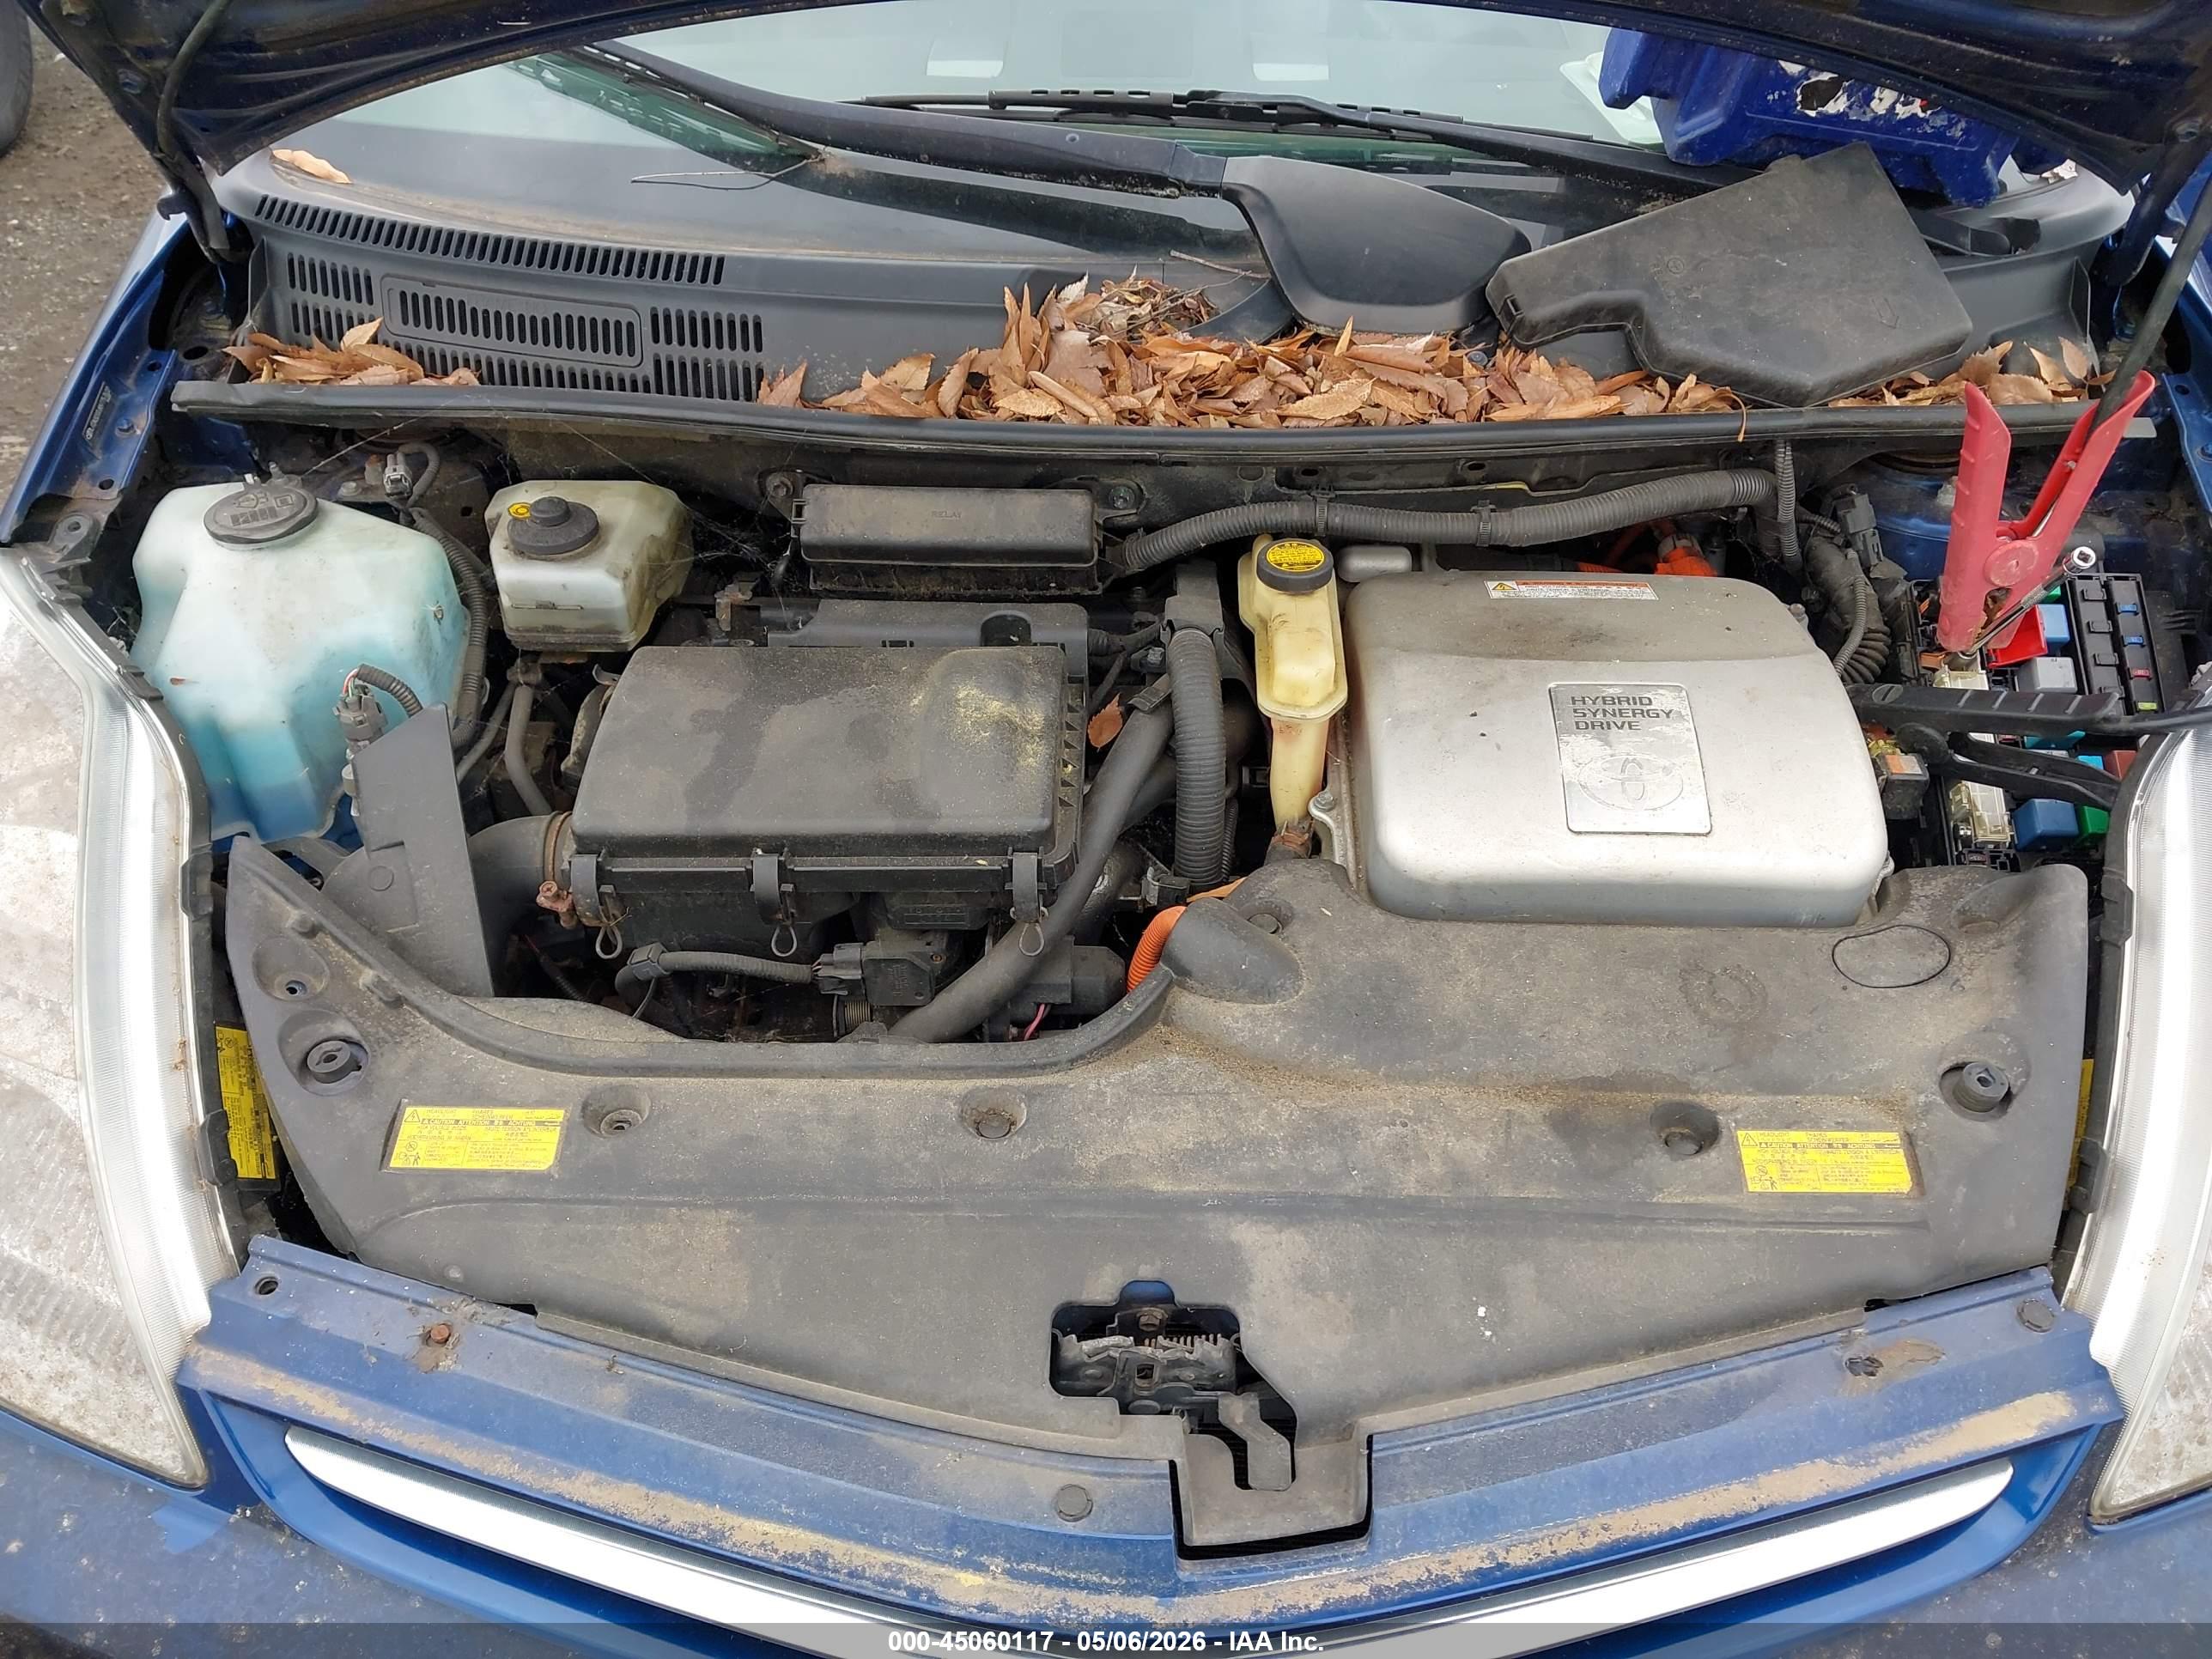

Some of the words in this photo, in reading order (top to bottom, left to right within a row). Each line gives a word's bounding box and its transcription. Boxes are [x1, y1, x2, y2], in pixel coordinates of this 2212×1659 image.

[1571, 696, 1653, 706] HYBRID
[1572, 708, 1674, 719] SYNERGY
[1575, 720, 1642, 731] DRIVE
